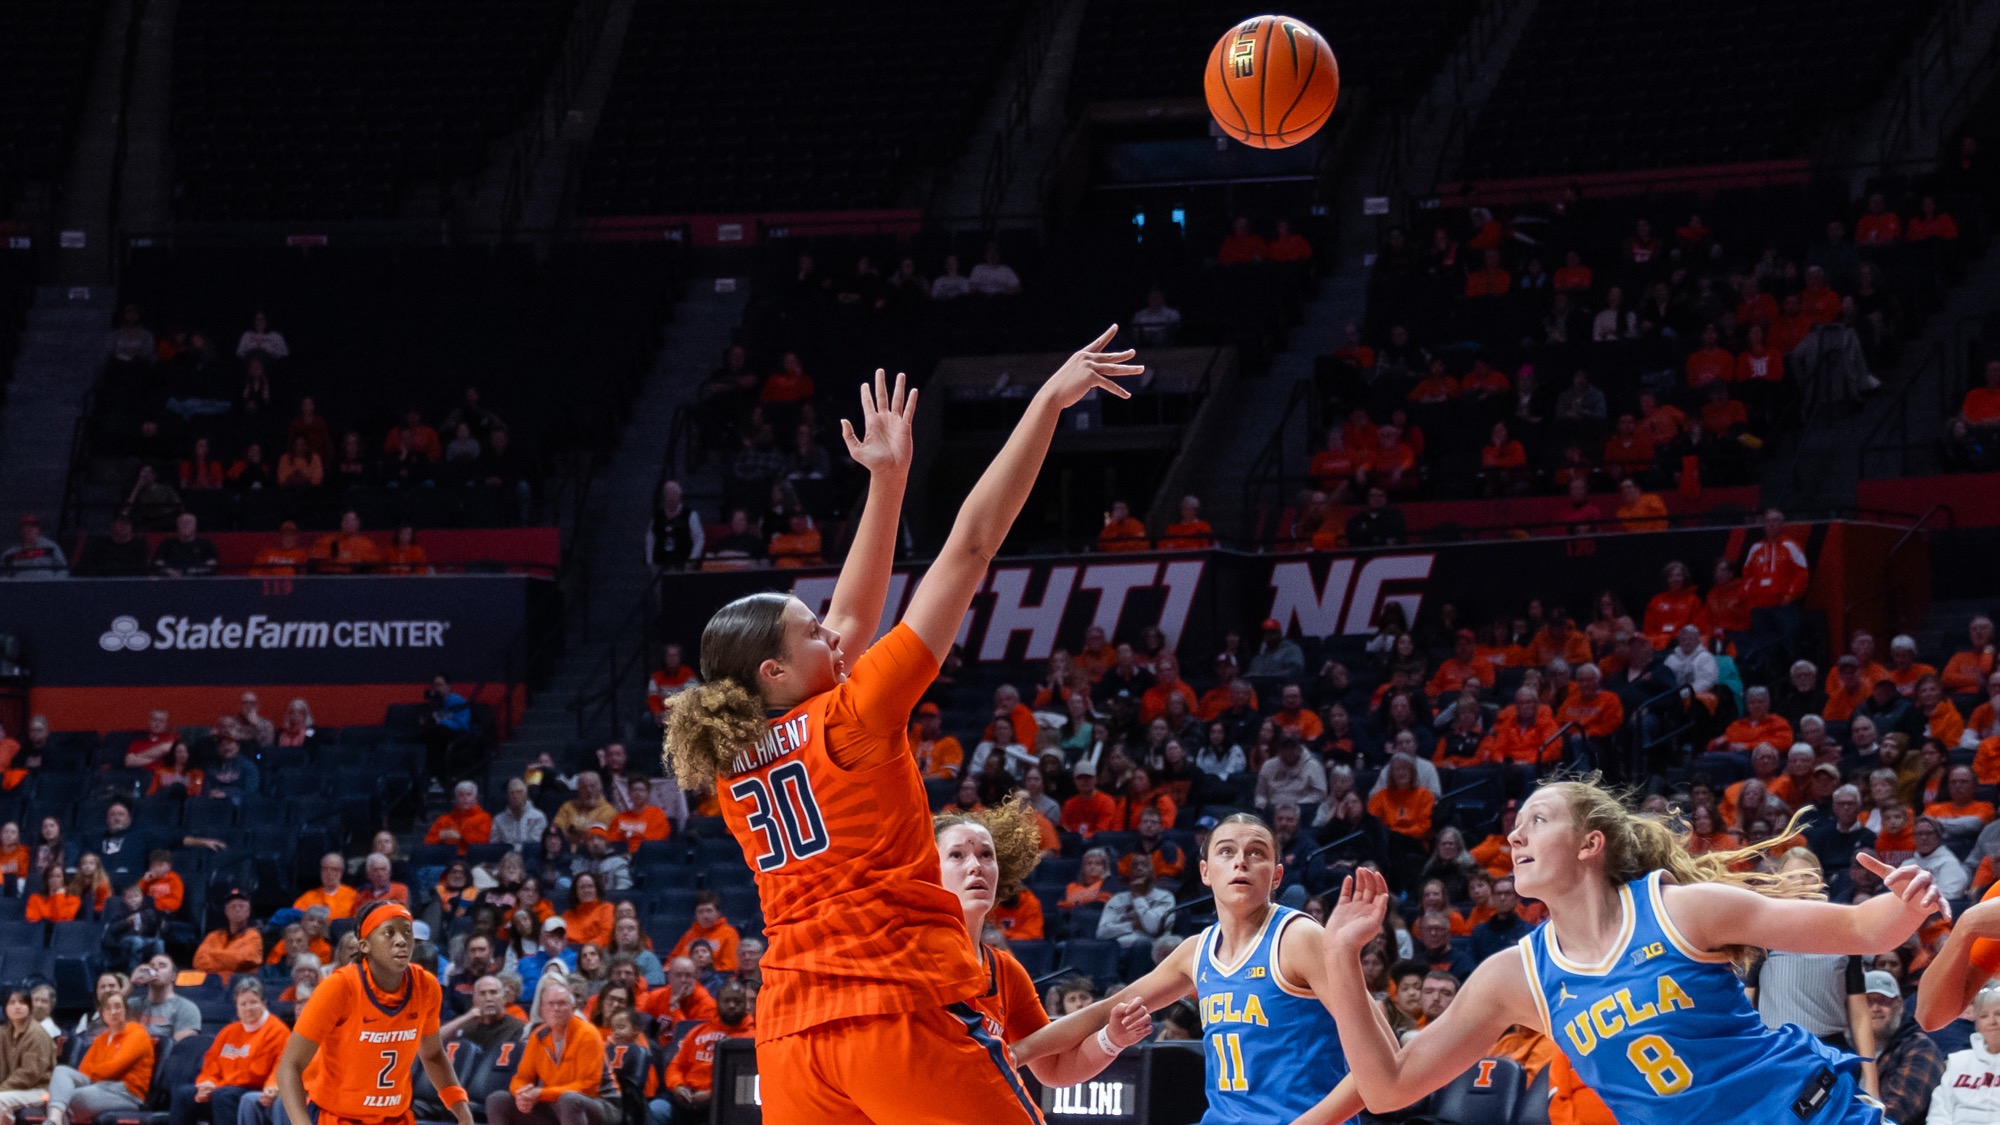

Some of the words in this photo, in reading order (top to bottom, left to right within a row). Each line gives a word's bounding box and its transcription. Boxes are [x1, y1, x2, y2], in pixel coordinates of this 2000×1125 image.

[730, 760, 830, 873] 30
[1200, 992, 1269, 1032] UCLA
[1564, 975, 1696, 1057] UCLA
[359, 1028, 418, 1043] FIGHTING
[377, 1050, 398, 1089] 2
[1212, 1033, 1249, 1092] 11
[1626, 1033, 1694, 1098] 8
[363, 1094, 402, 1107] ILLINI
[1052, 1081, 1123, 1116] ILLINI
